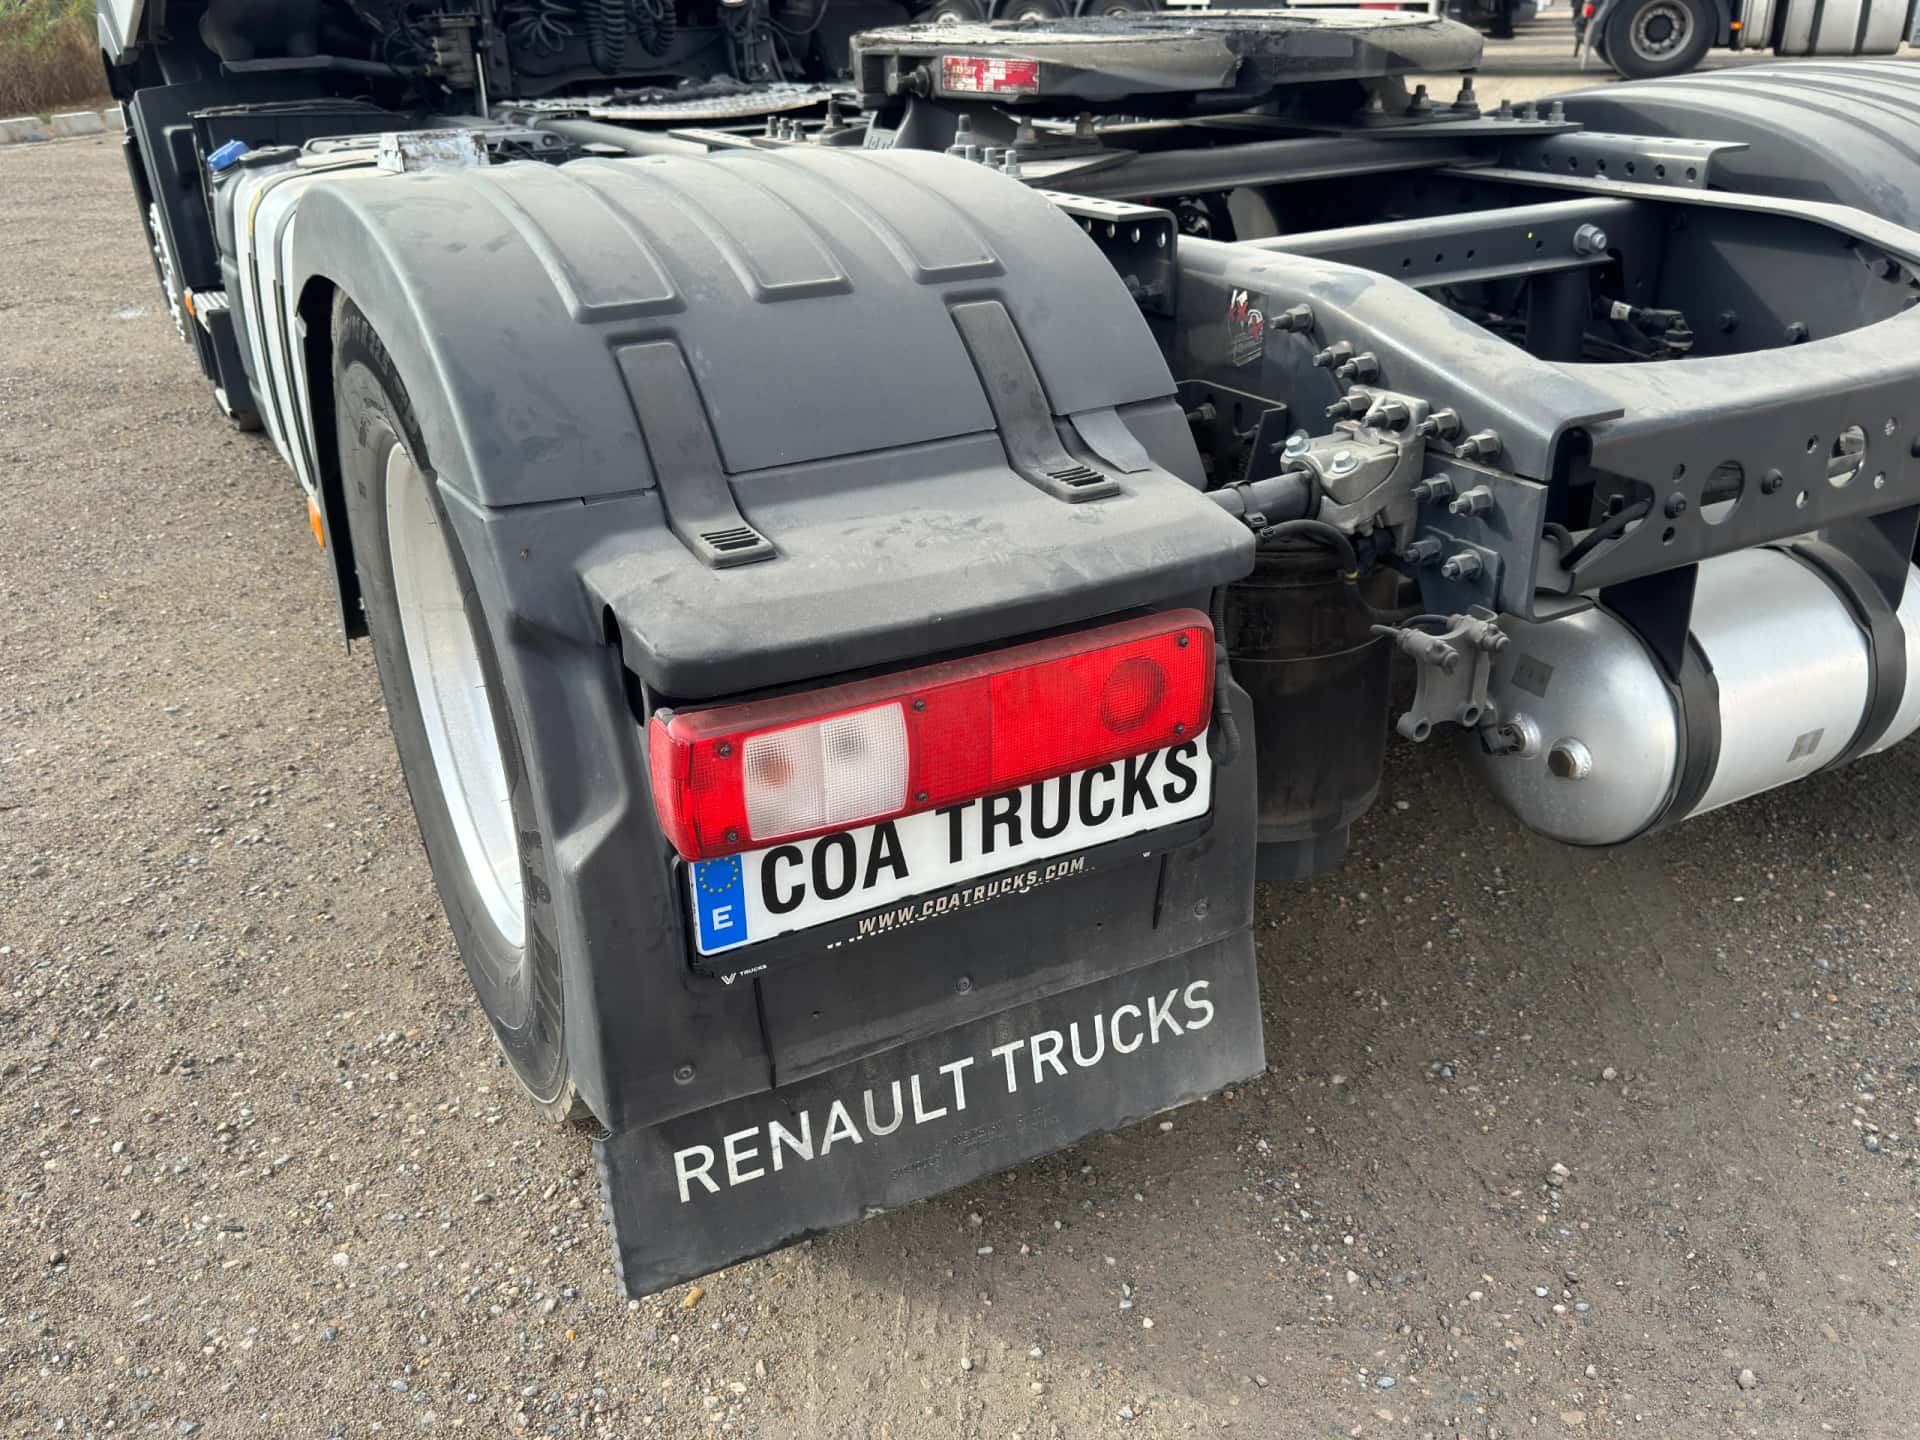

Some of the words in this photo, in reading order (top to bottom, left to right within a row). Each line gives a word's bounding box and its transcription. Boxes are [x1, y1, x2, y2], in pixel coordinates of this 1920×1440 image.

[760, 821, 909, 914] COA
[935, 739, 1198, 864] TRUCKS
[712, 904, 734, 931] E
[858, 856, 1084, 934] WWW.COATRUCKS.COM
[673, 1057, 976, 1202] RENAULT
[991, 980, 1215, 1093] TRUCKS
